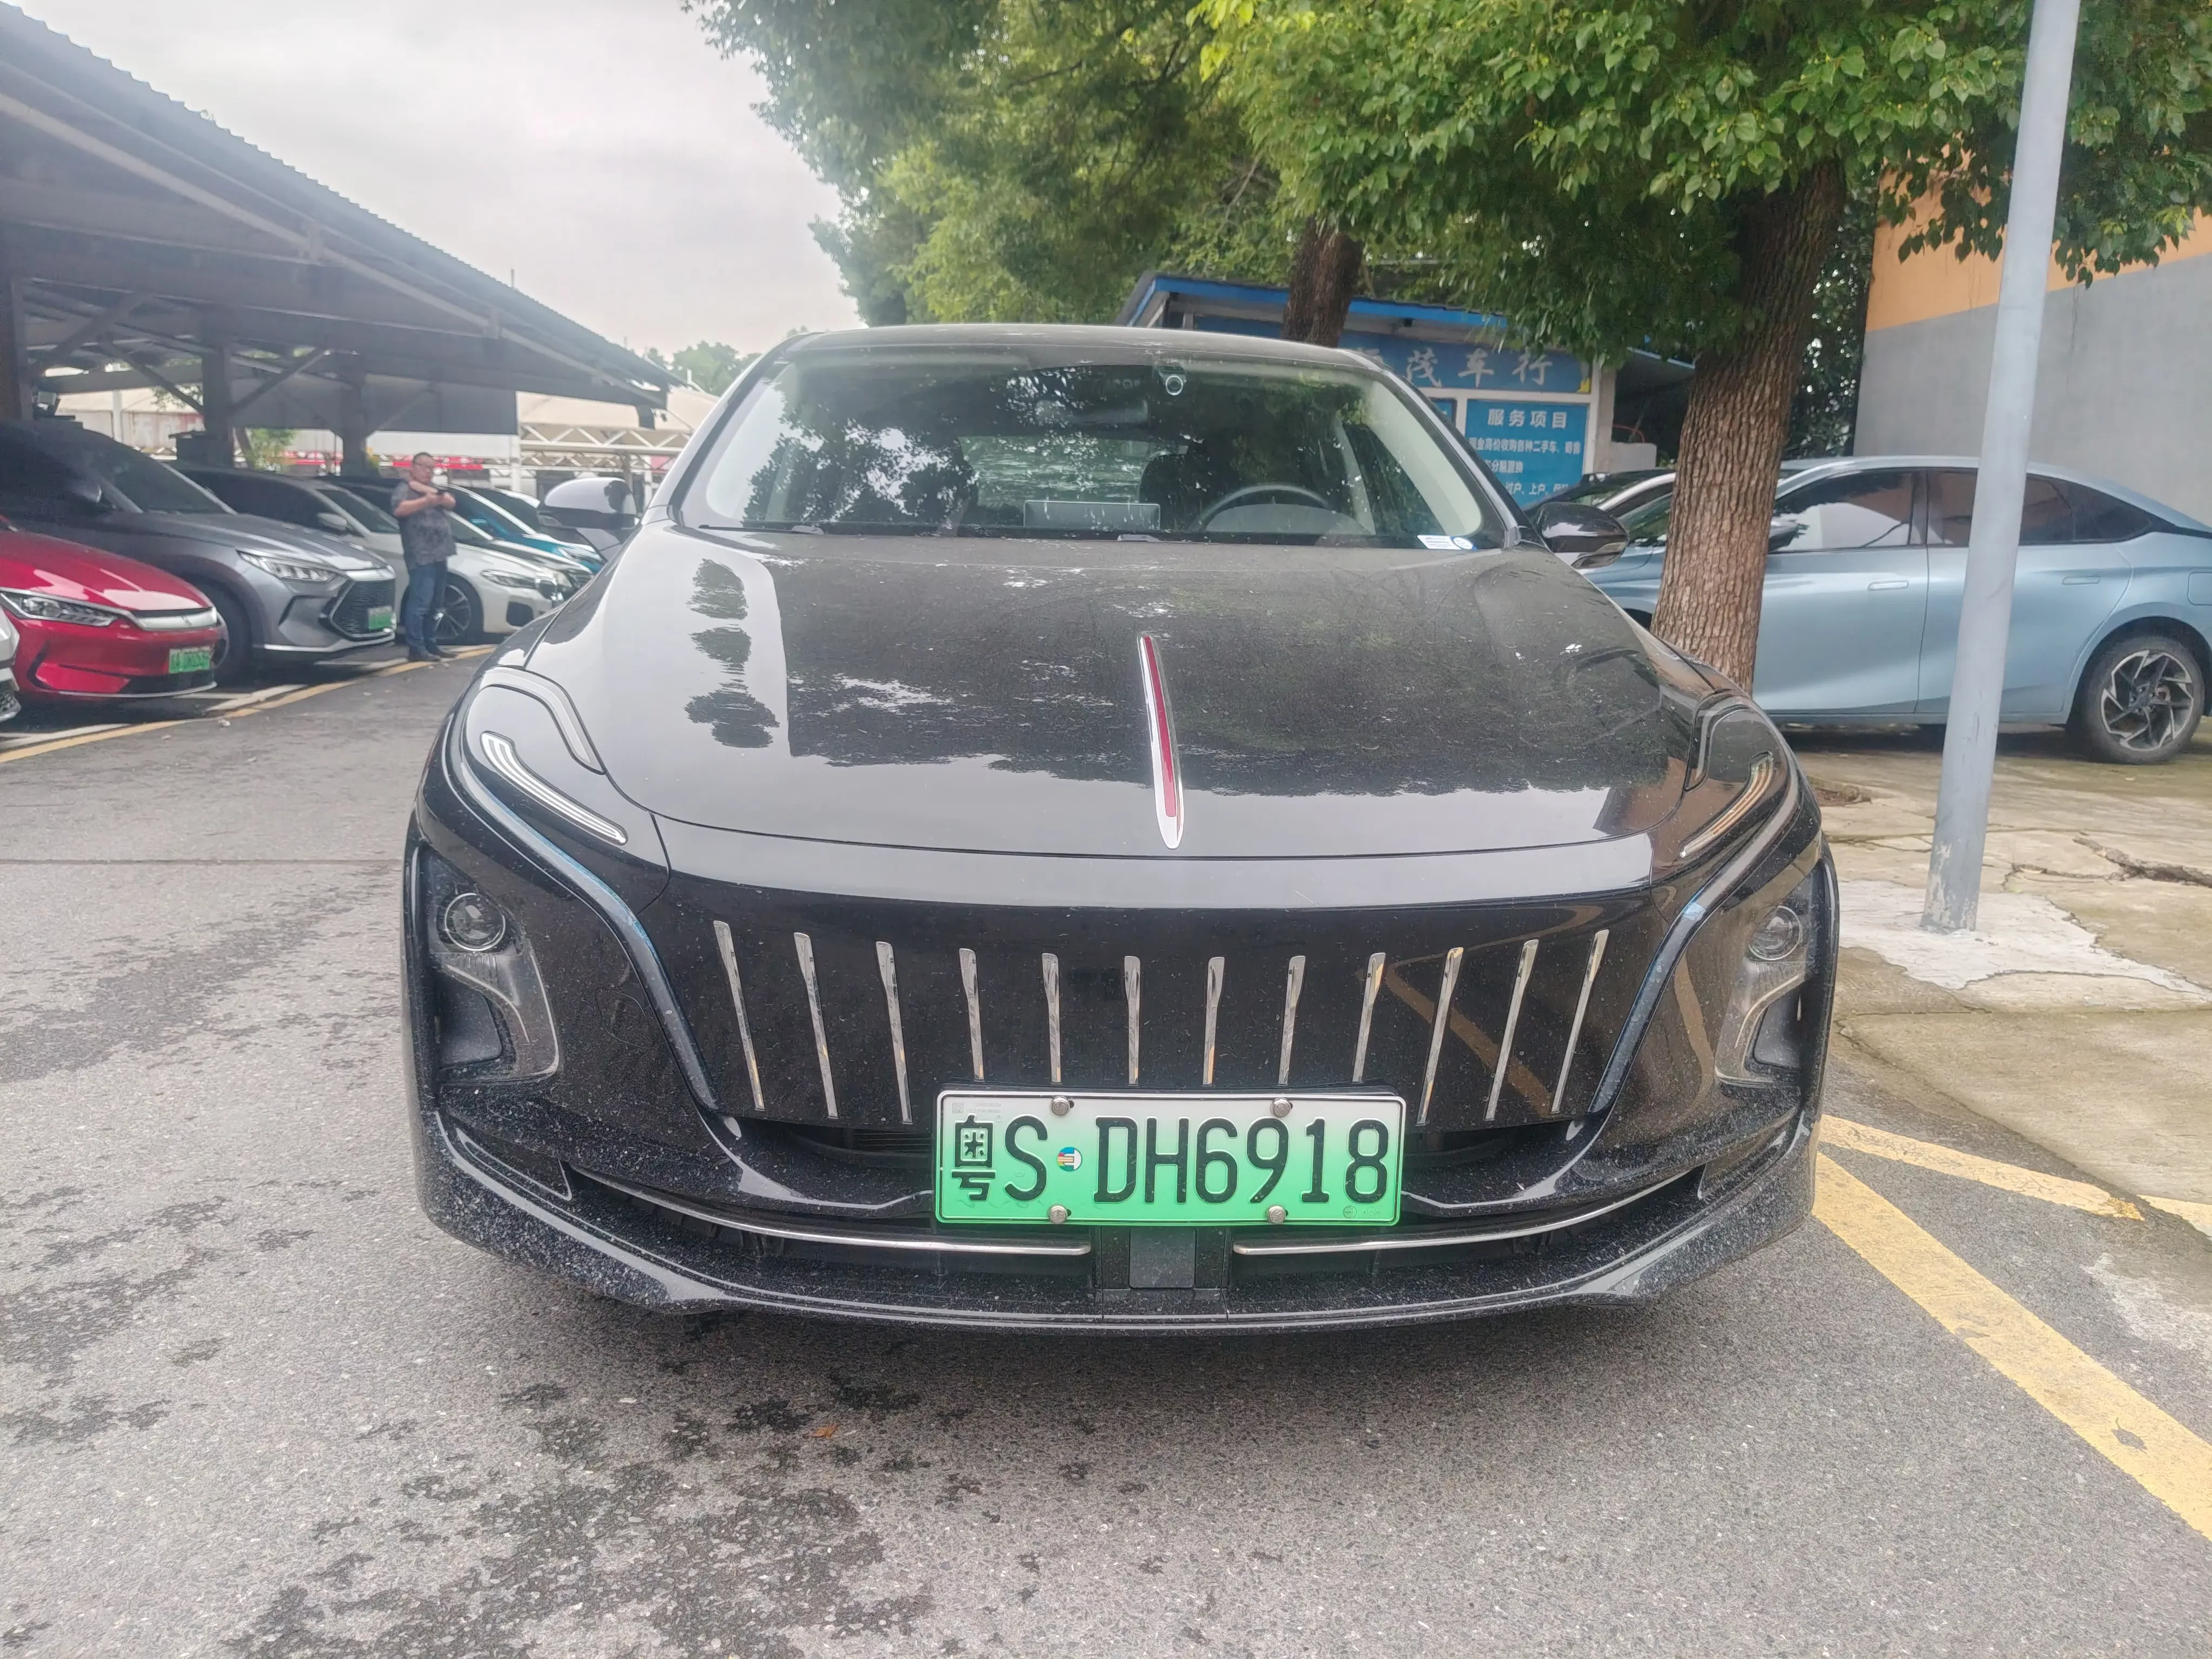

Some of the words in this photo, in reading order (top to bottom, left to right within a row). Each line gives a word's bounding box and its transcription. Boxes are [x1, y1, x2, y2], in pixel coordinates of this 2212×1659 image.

[1358, 347, 1552, 388] 茂车行
[1488, 409, 1567, 429] 服务项目
[1094, 1116, 1391, 1204] DH6918
